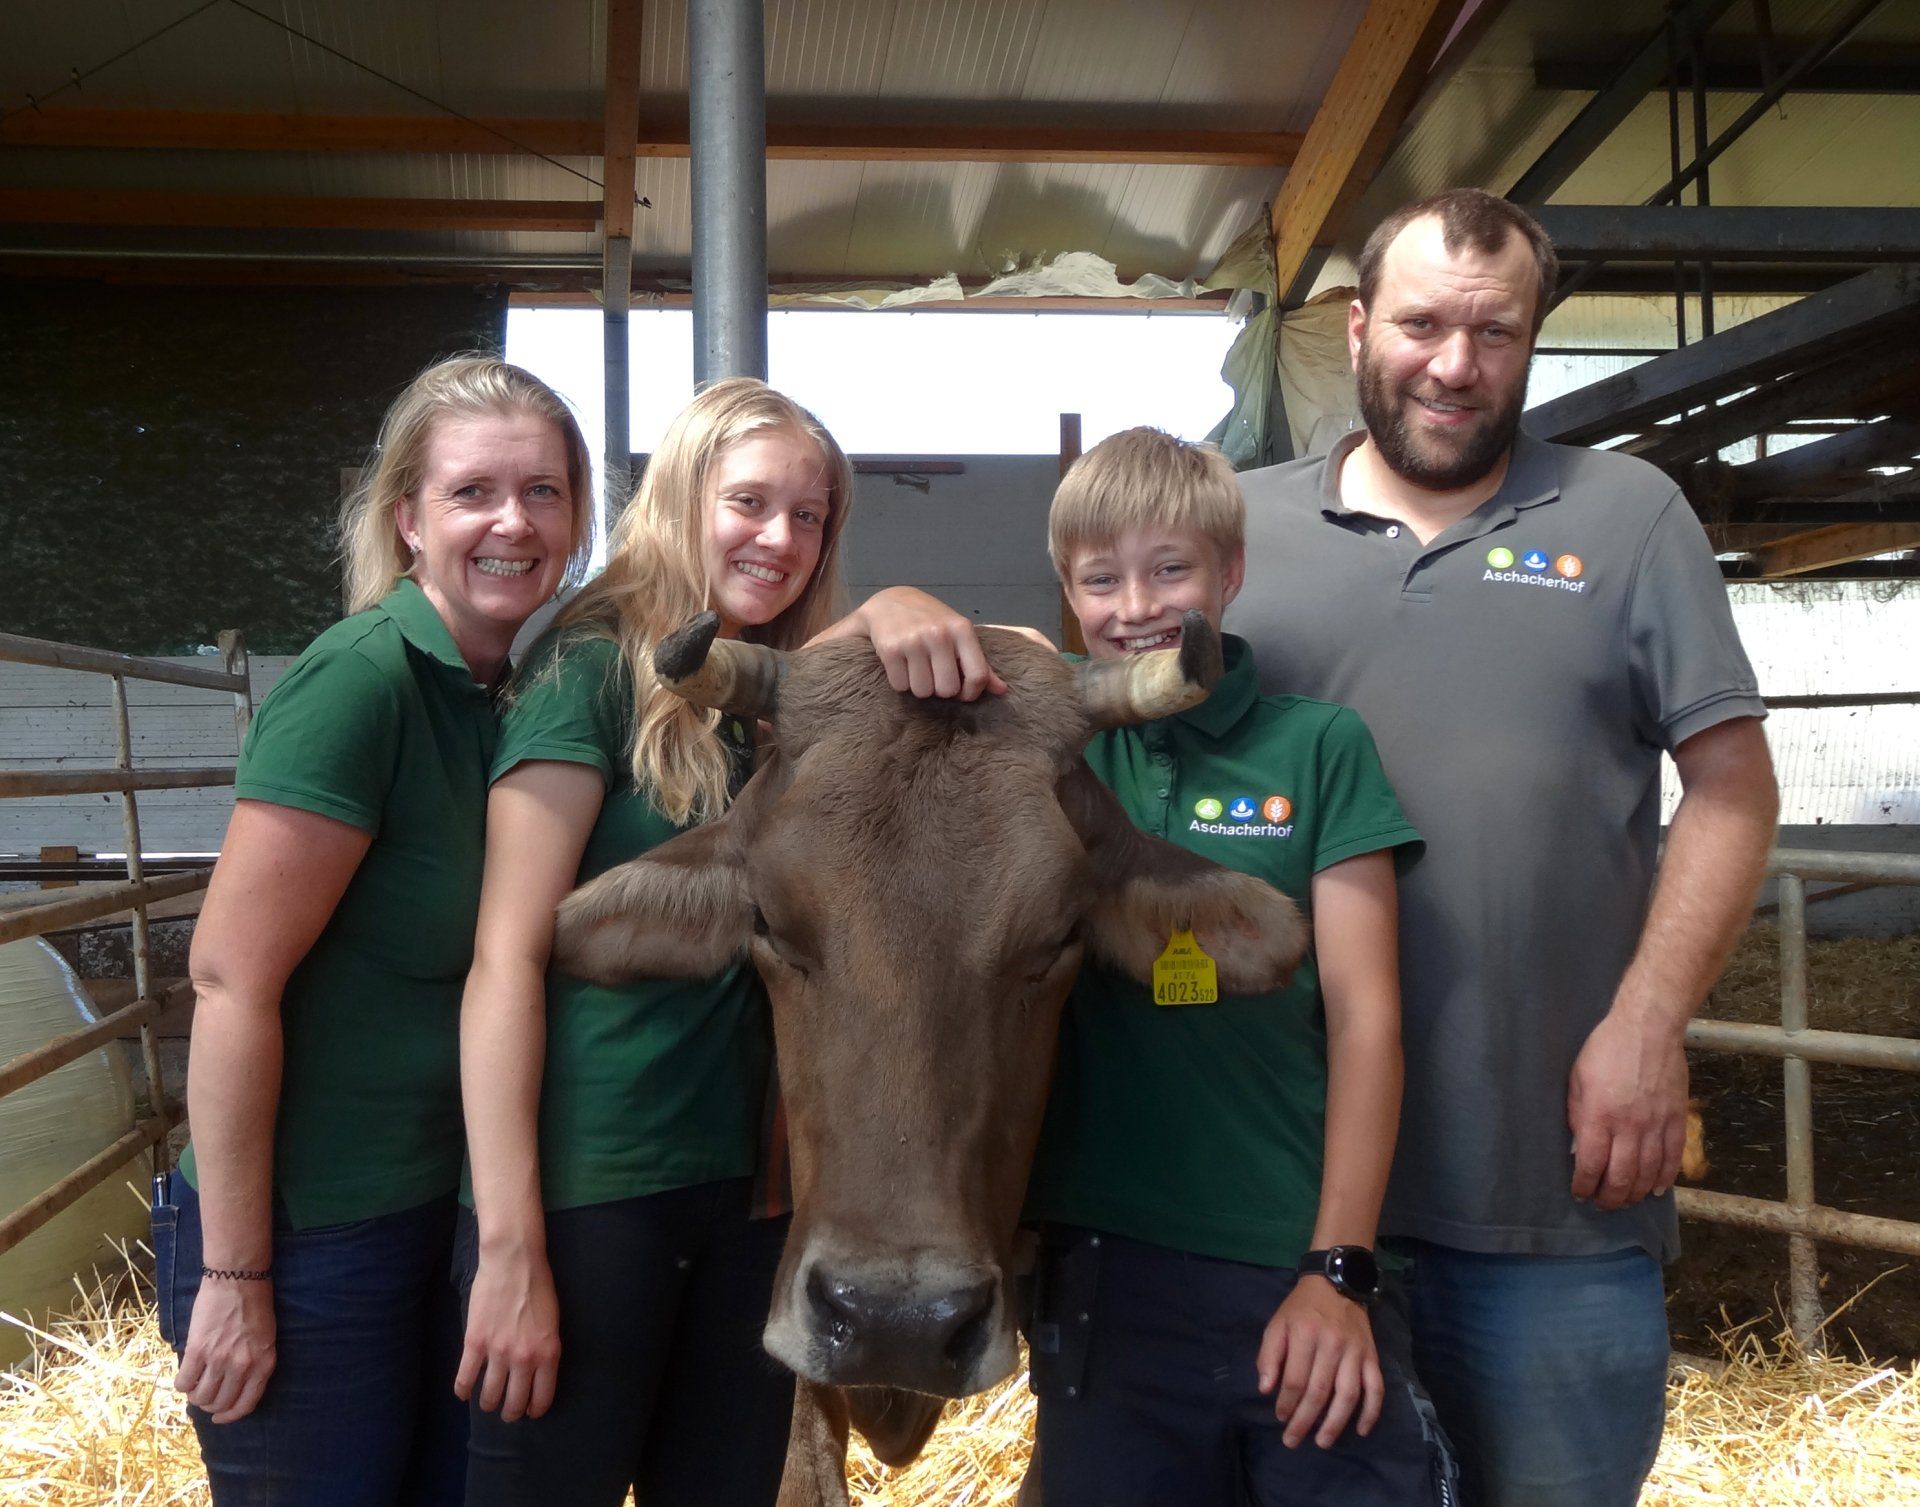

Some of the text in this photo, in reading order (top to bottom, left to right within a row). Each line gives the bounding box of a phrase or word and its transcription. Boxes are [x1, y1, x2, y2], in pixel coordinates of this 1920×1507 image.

[1482, 569, 1585, 592] Aschacherhof
[1189, 820, 1294, 838] Aschacherhof
[1157, 981, 1215, 1002] 4023 522
